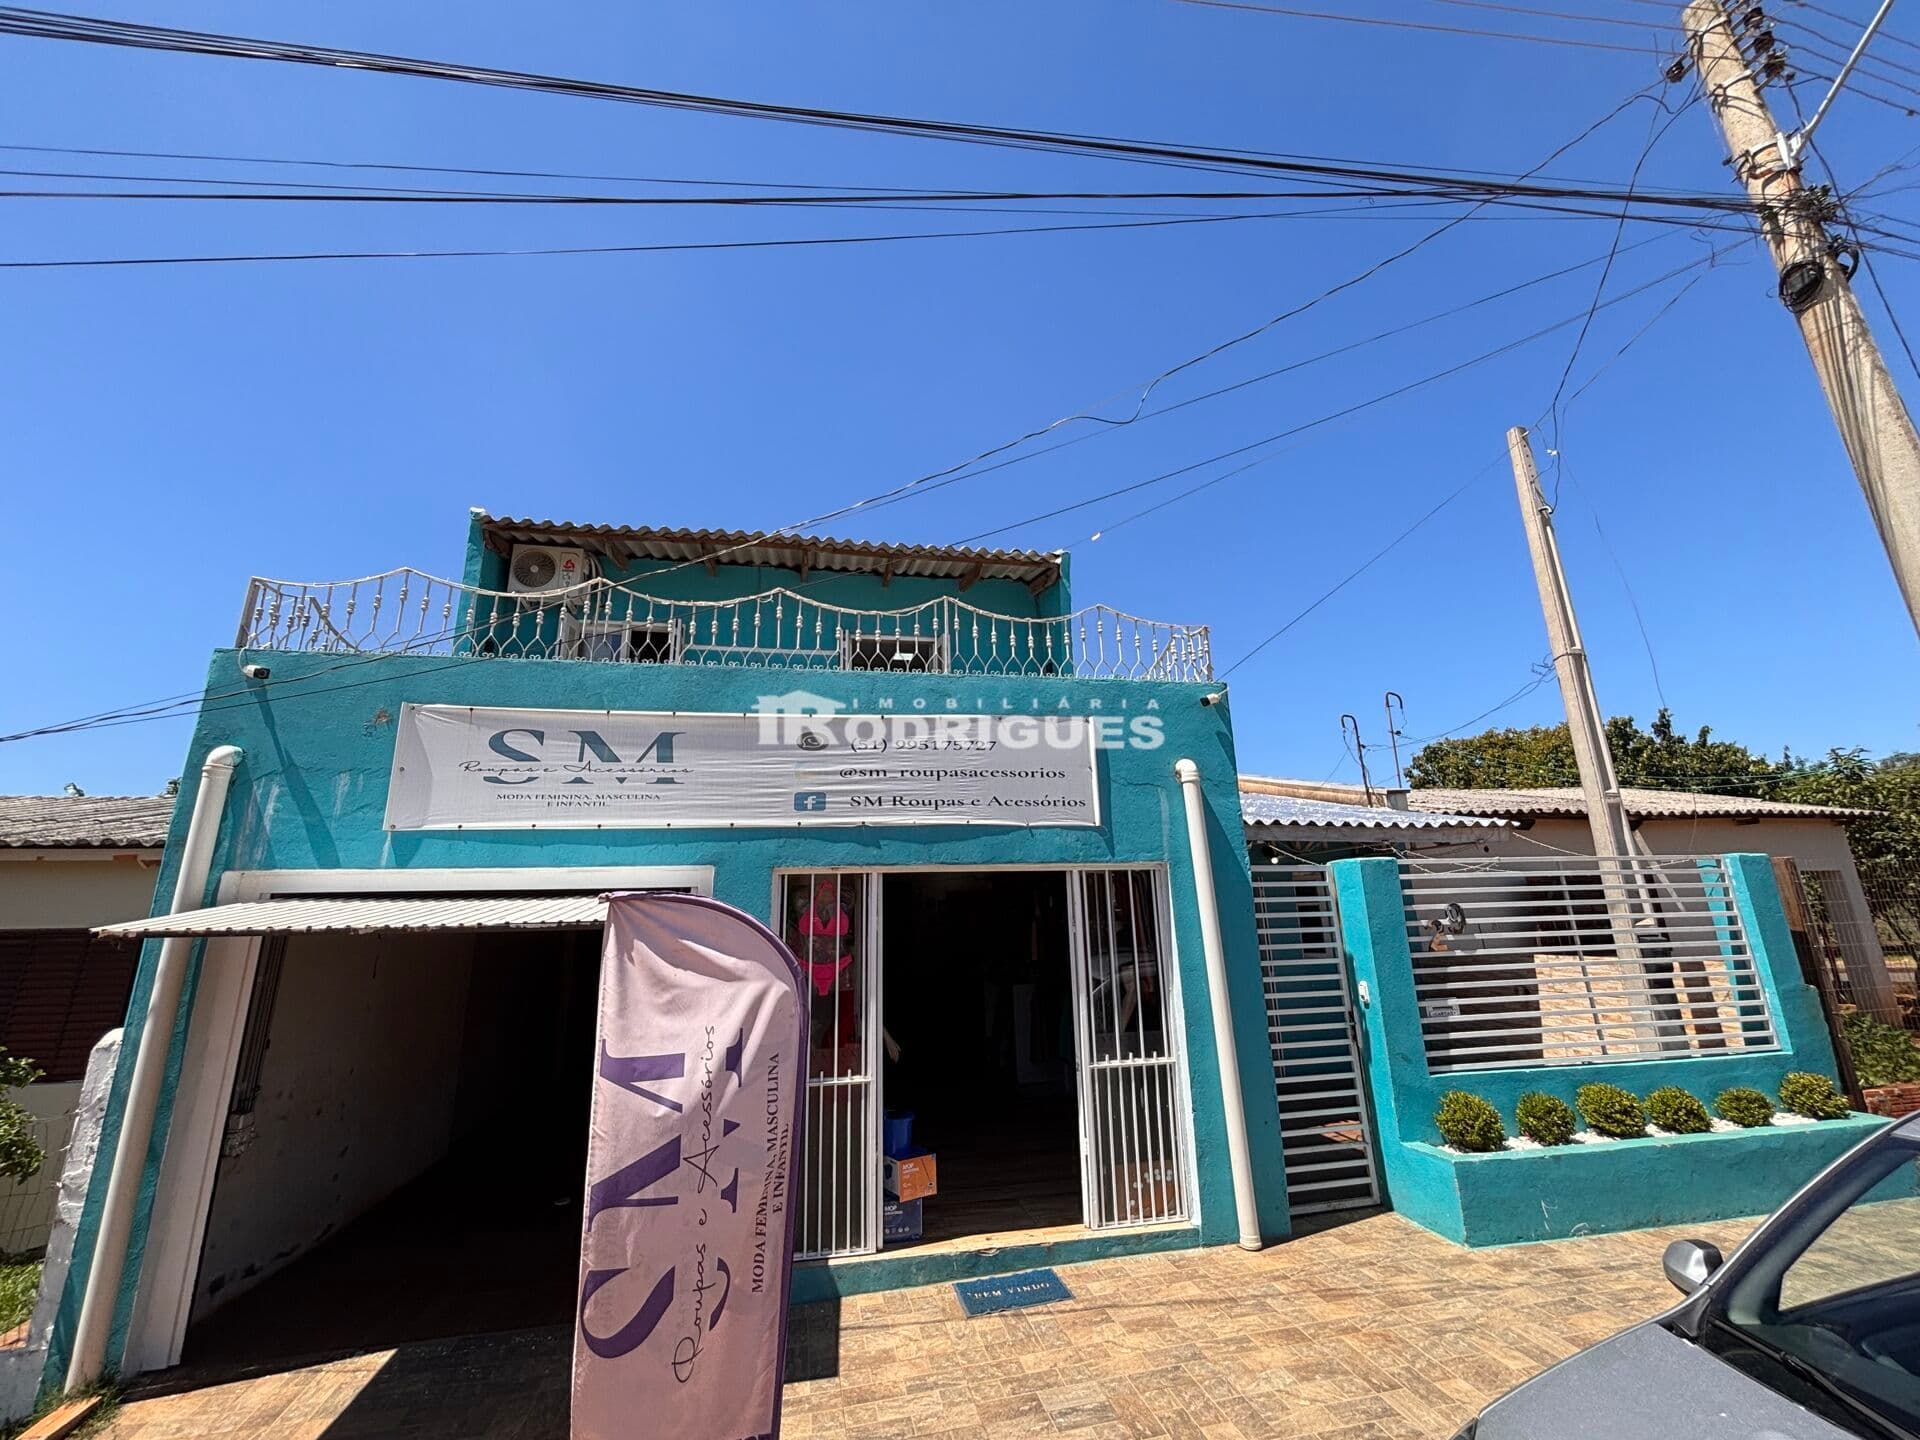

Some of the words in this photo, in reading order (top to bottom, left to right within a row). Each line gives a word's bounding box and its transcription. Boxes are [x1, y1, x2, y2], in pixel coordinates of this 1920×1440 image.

[895, 739, 997, 751] 995175727
[483, 728, 686, 785] SM
[459, 760, 539, 776] Roupas
[563, 760, 694, 774] Acessórios
[838, 766, 1066, 780] @sm_roupasacessorios
[849, 795, 883, 808] SM
[891, 795, 966, 809] Roupas
[972, 799, 982, 807] e
[988, 793, 1086, 808] Acessórios
[683, 1025, 720, 1195] Acessórios
[751, 1242, 767, 1293] MODA
[766, 1053, 780, 1152] MASCULINA
[580, 1028, 744, 1359] SM
[772, 1202, 783, 1213] E
[698, 1208, 708, 1226] e
[671, 1243, 717, 1384] Roupas
